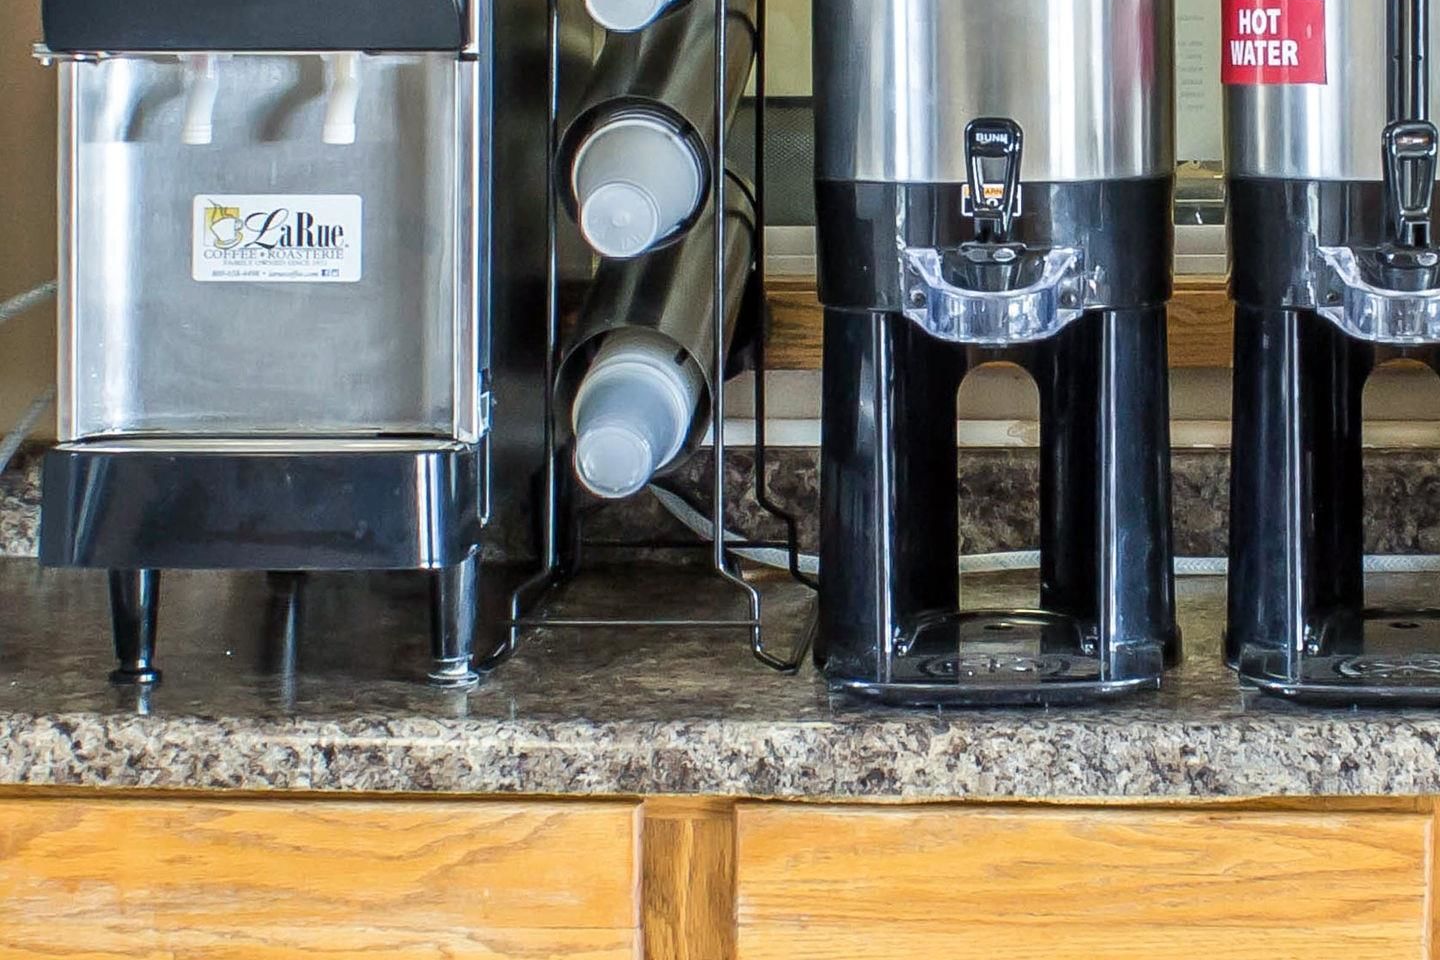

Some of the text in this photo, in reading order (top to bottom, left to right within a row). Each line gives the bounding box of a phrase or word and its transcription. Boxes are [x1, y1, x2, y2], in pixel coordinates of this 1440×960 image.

[1239, 8, 1281, 35] HOT
[1230, 40, 1299, 66] WATER
[244, 208, 345, 250] LaRue
[203, 248, 344, 260] COFFEE ROASTERIE
